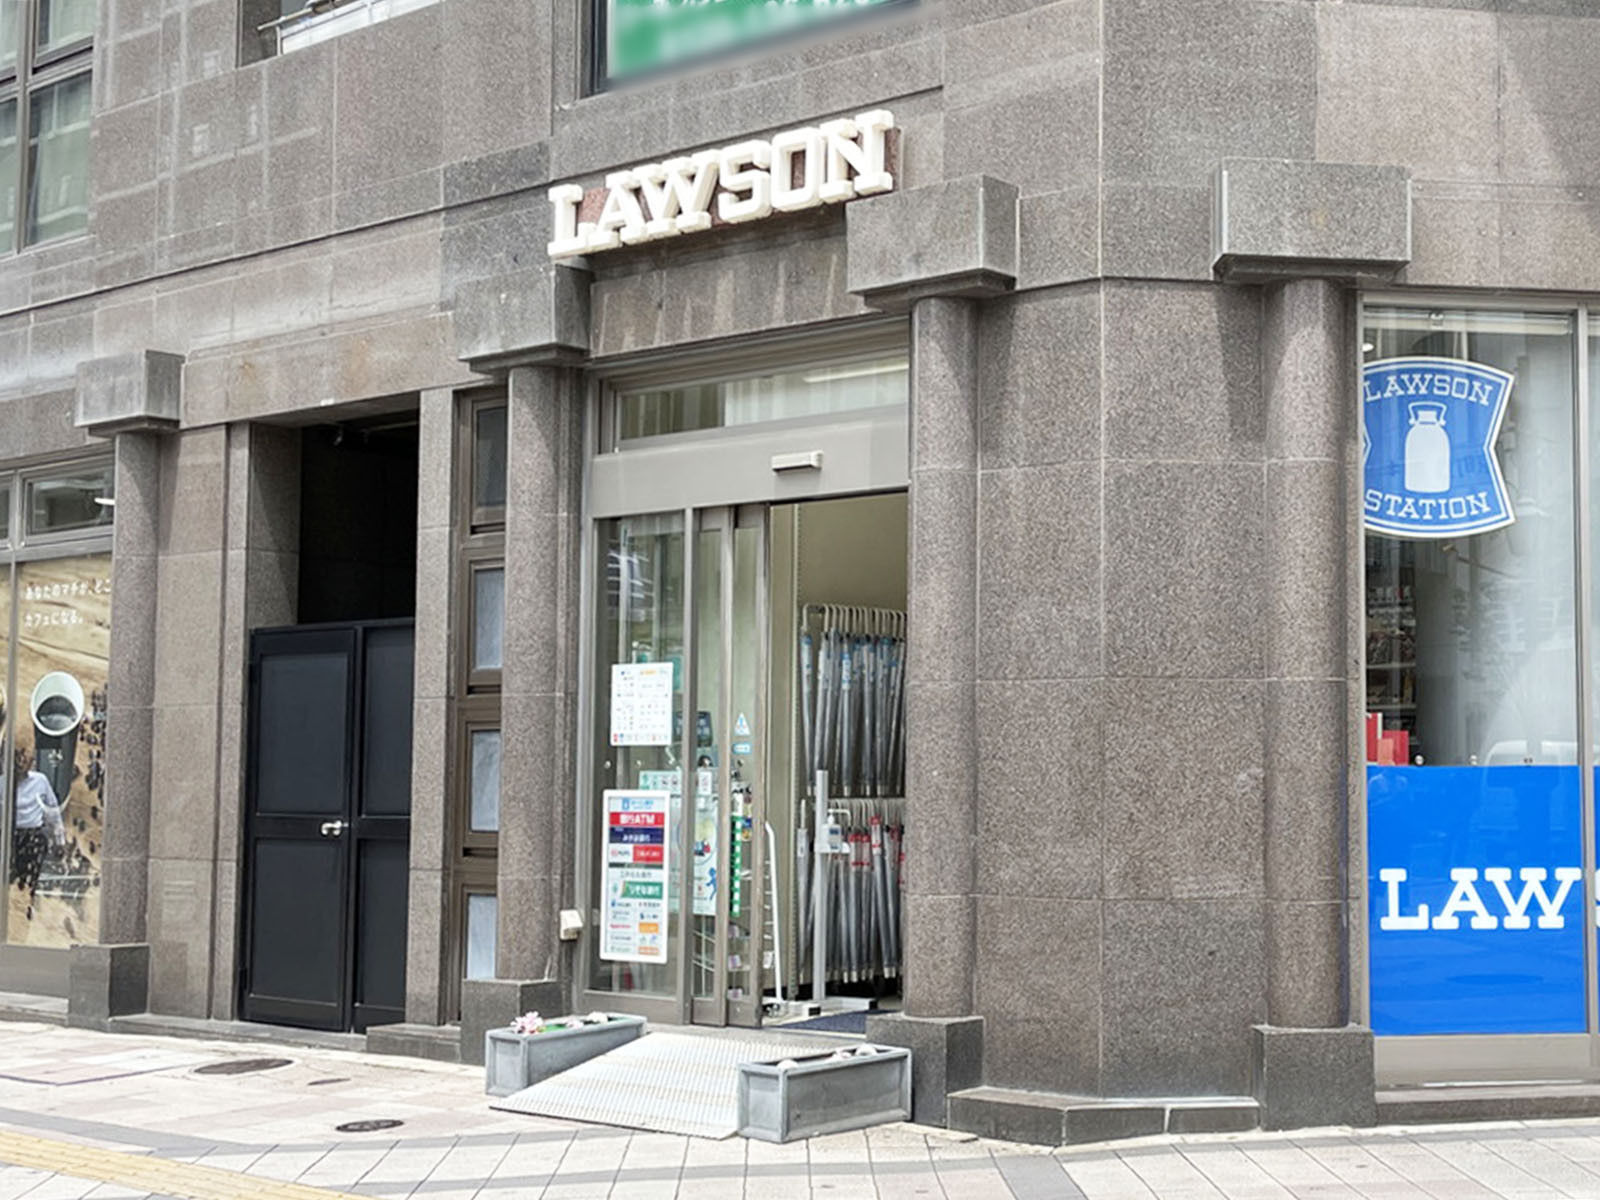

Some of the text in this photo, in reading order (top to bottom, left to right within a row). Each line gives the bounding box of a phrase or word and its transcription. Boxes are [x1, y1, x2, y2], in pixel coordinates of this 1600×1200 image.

[548, 109, 894, 257] LAWSON
[1364, 374, 1493, 406] LAWSON
[1364, 489, 1491, 520] STATION
